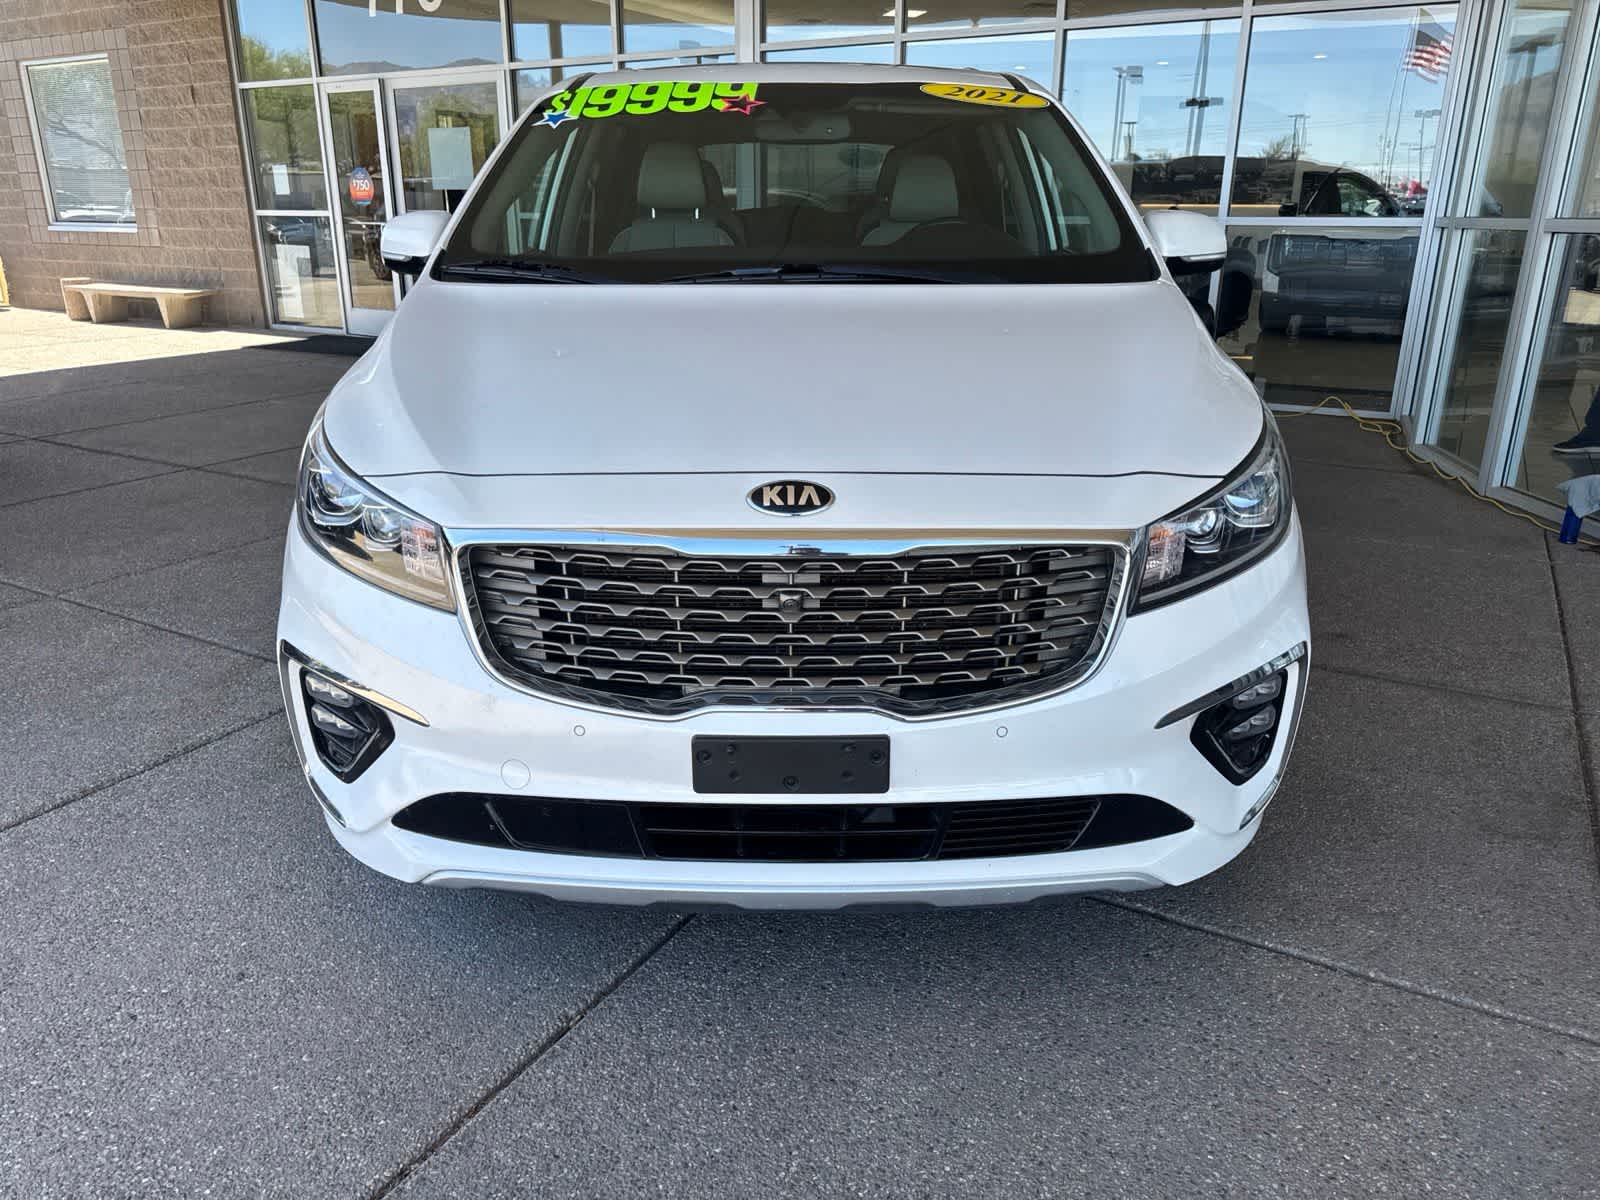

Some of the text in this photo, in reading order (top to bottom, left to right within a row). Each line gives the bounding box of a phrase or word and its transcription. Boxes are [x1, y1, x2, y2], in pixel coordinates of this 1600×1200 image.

[545, 81, 759, 118] $19999
[944, 86, 1024, 105] 2021
[762, 485, 822, 507] KIA
